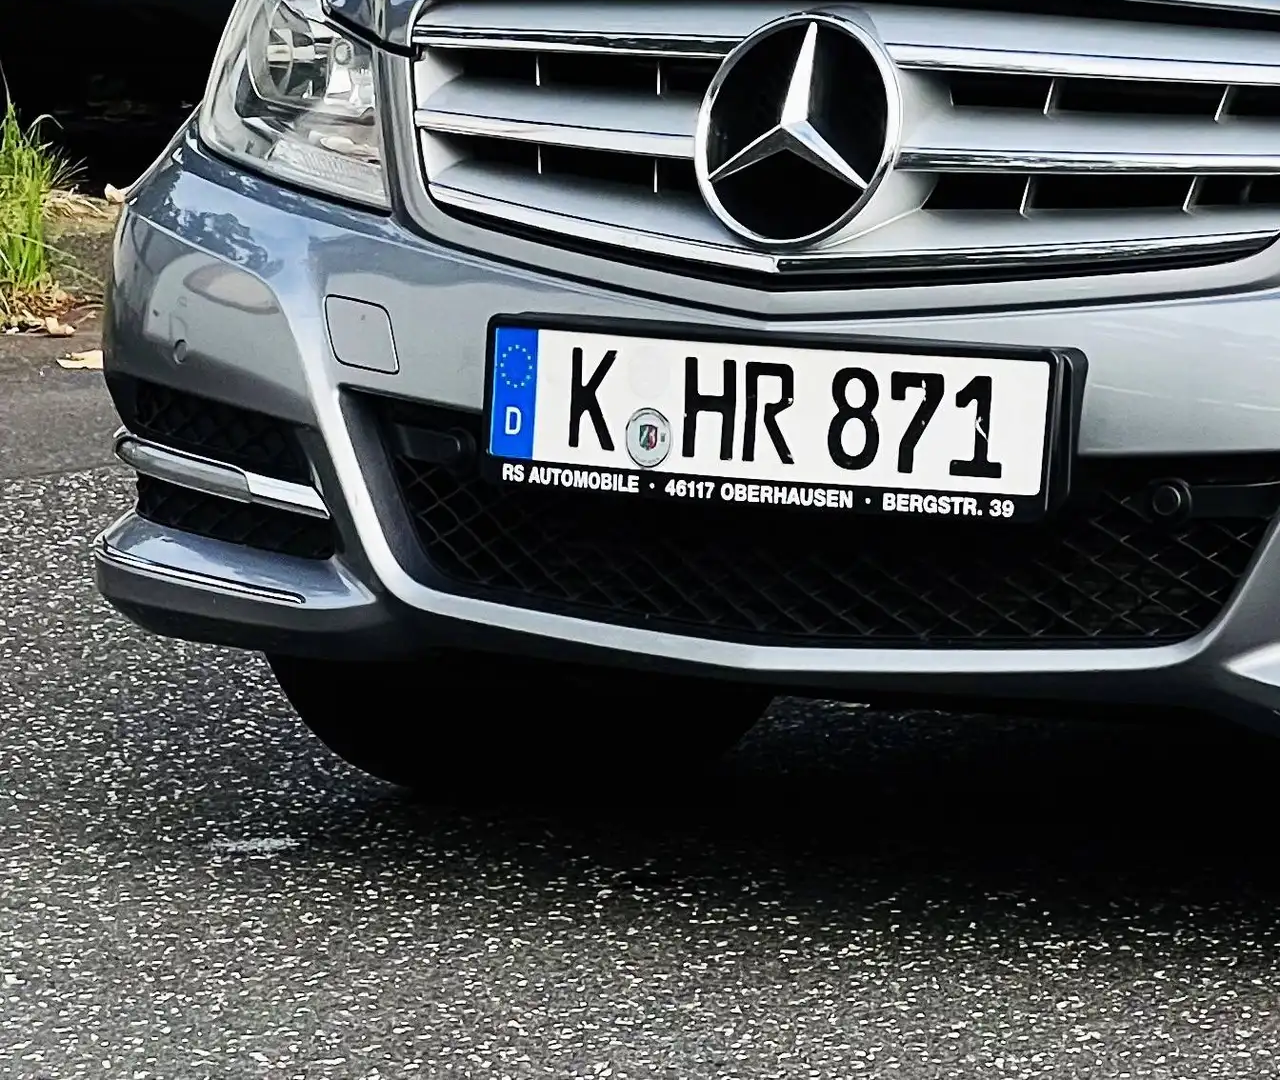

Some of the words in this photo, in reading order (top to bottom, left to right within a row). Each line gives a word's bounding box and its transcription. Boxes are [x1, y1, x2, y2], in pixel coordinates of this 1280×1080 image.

[504, 406, 522, 435] D
[568, 346, 618, 452] K
[681, 356, 795, 465] HR
[828, 367, 1002, 479] 871
[502, 463, 525, 483] RS
[528, 467, 640, 493] AUTOMOBILE
[664, 478, 716, 500] 46117
[720, 482, 854, 509] OBERHAUSEN
[882, 492, 983, 517] BERGSTR.
[988, 498, 1015, 518] 39
